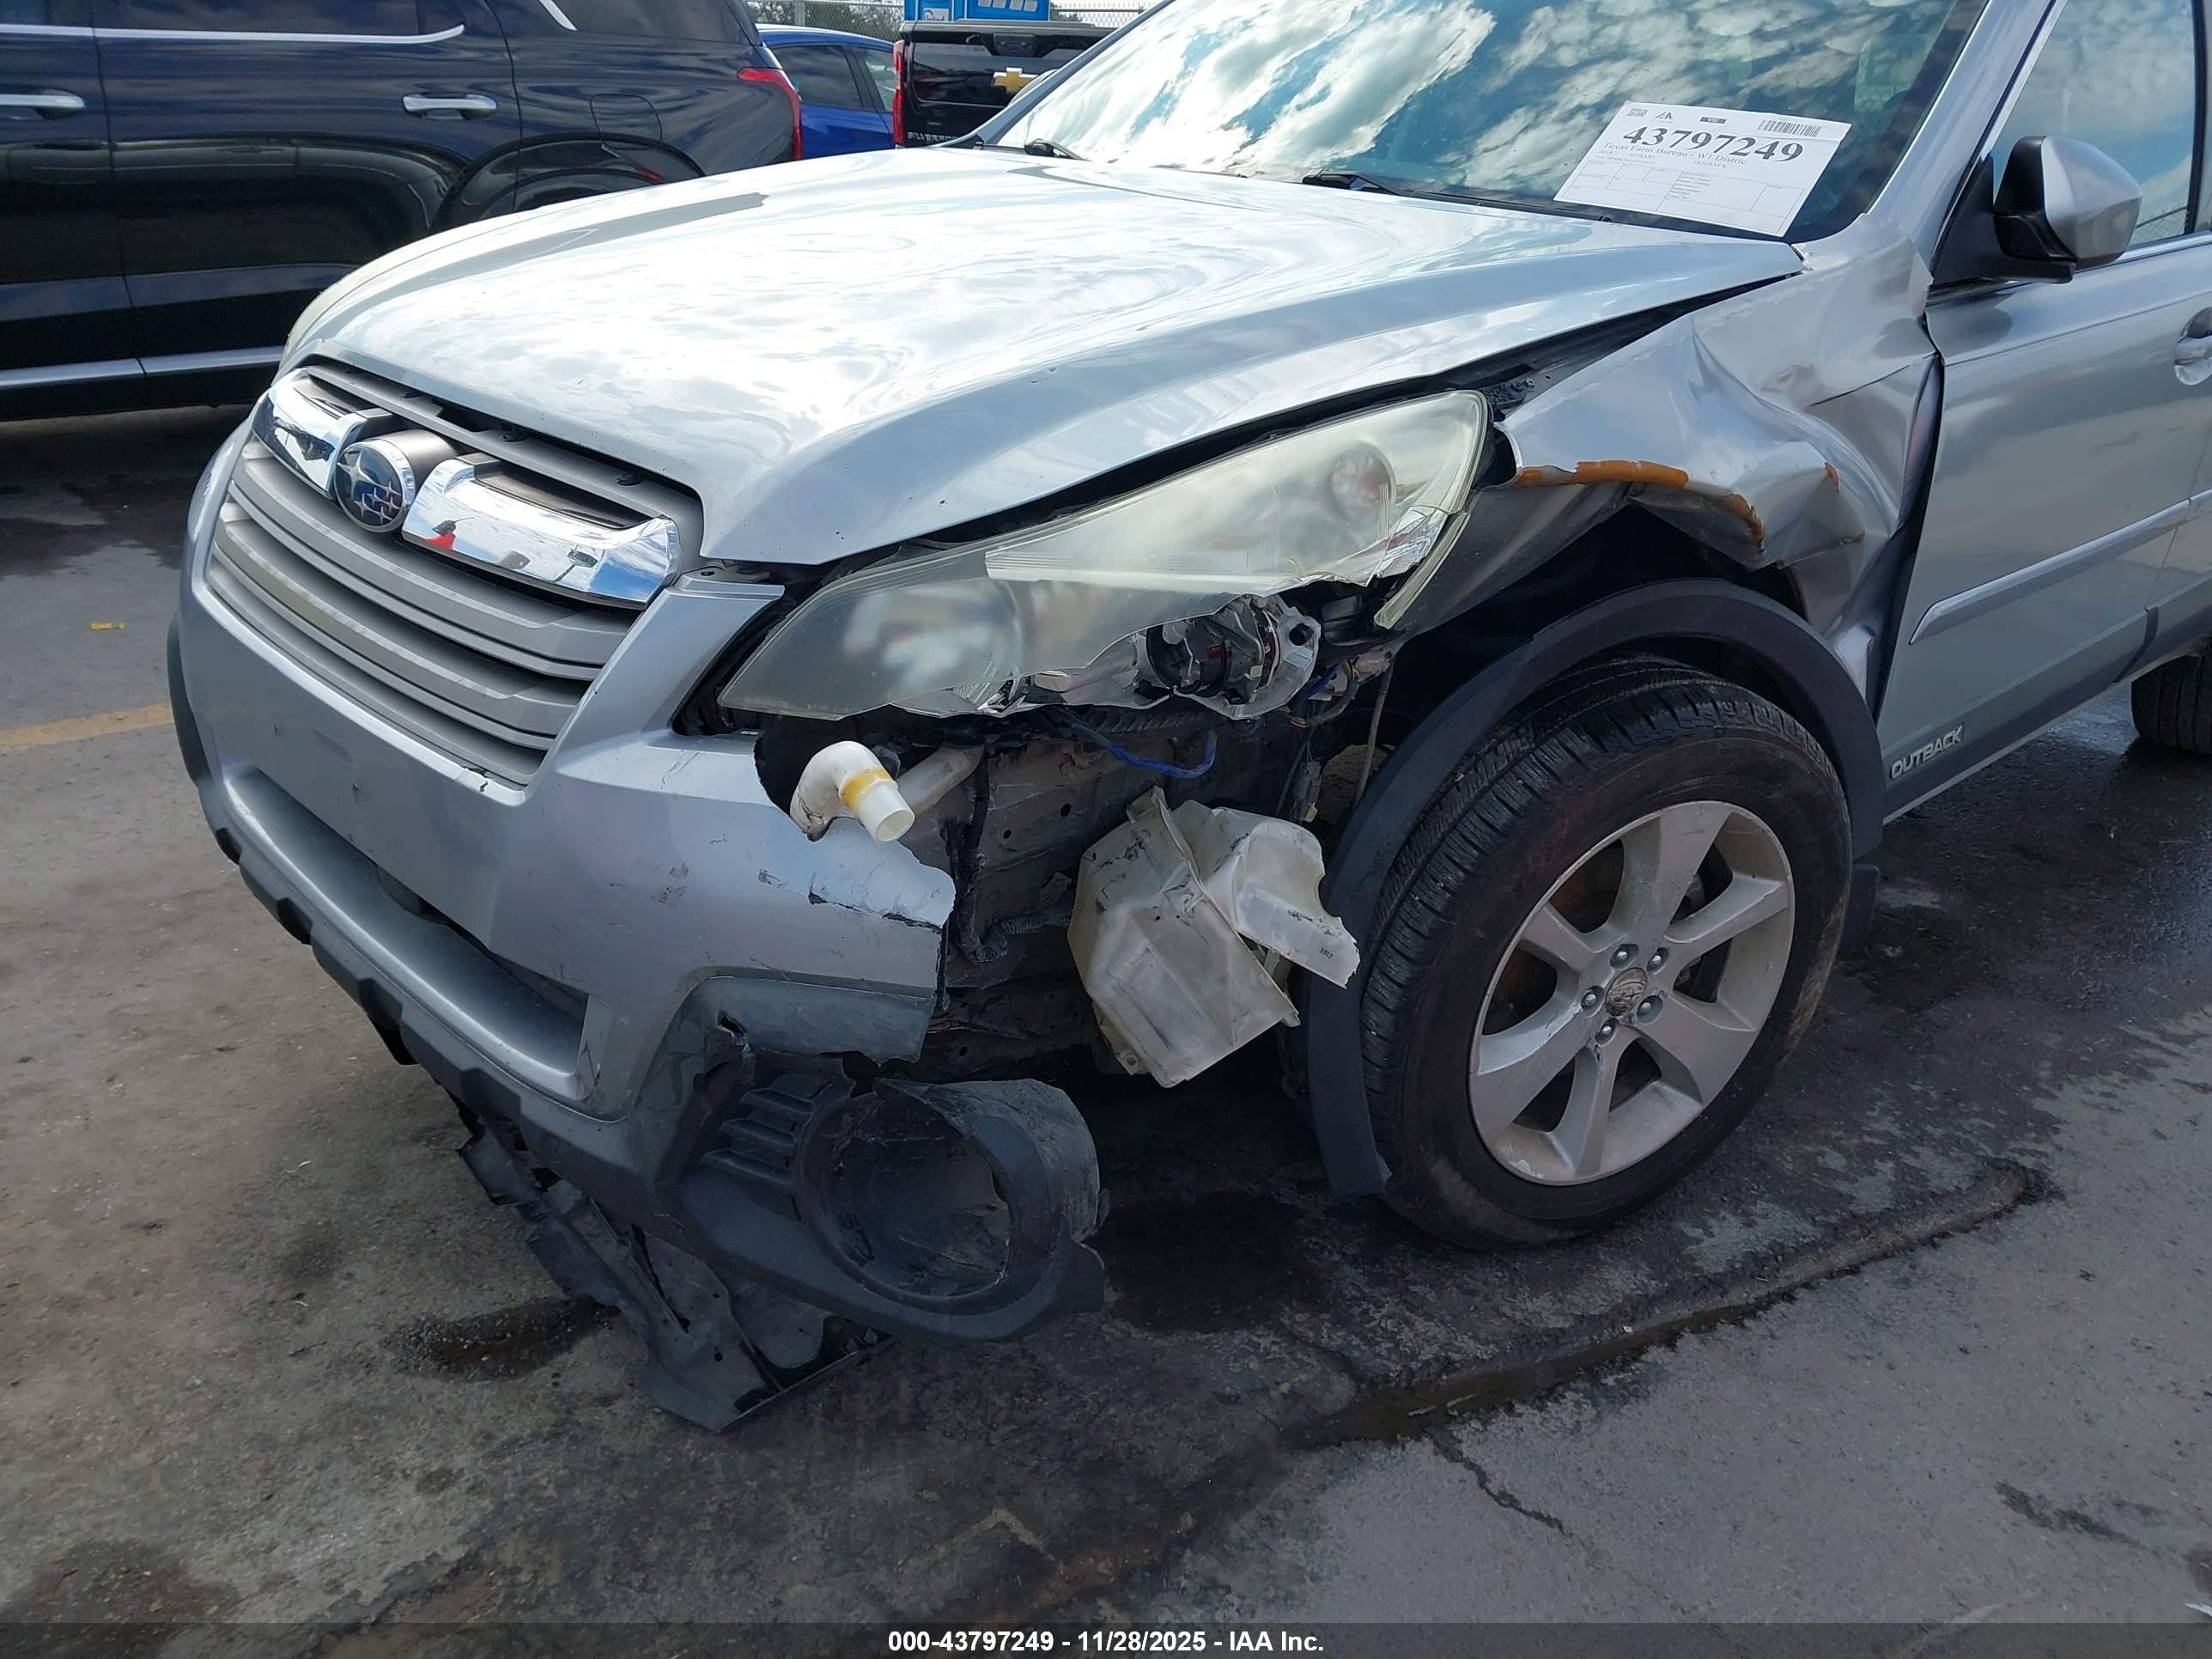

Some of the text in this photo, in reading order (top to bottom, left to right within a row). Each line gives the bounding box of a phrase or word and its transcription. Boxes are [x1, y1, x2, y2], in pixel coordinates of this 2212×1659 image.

[1603, 143, 1629, 151] Texas
[1631, 144, 1654, 153] Farm
[1656, 148, 1688, 157] Bureau
[1623, 126, 1804, 162] 43797249
[1891, 725, 1963, 780] OUTBACK
